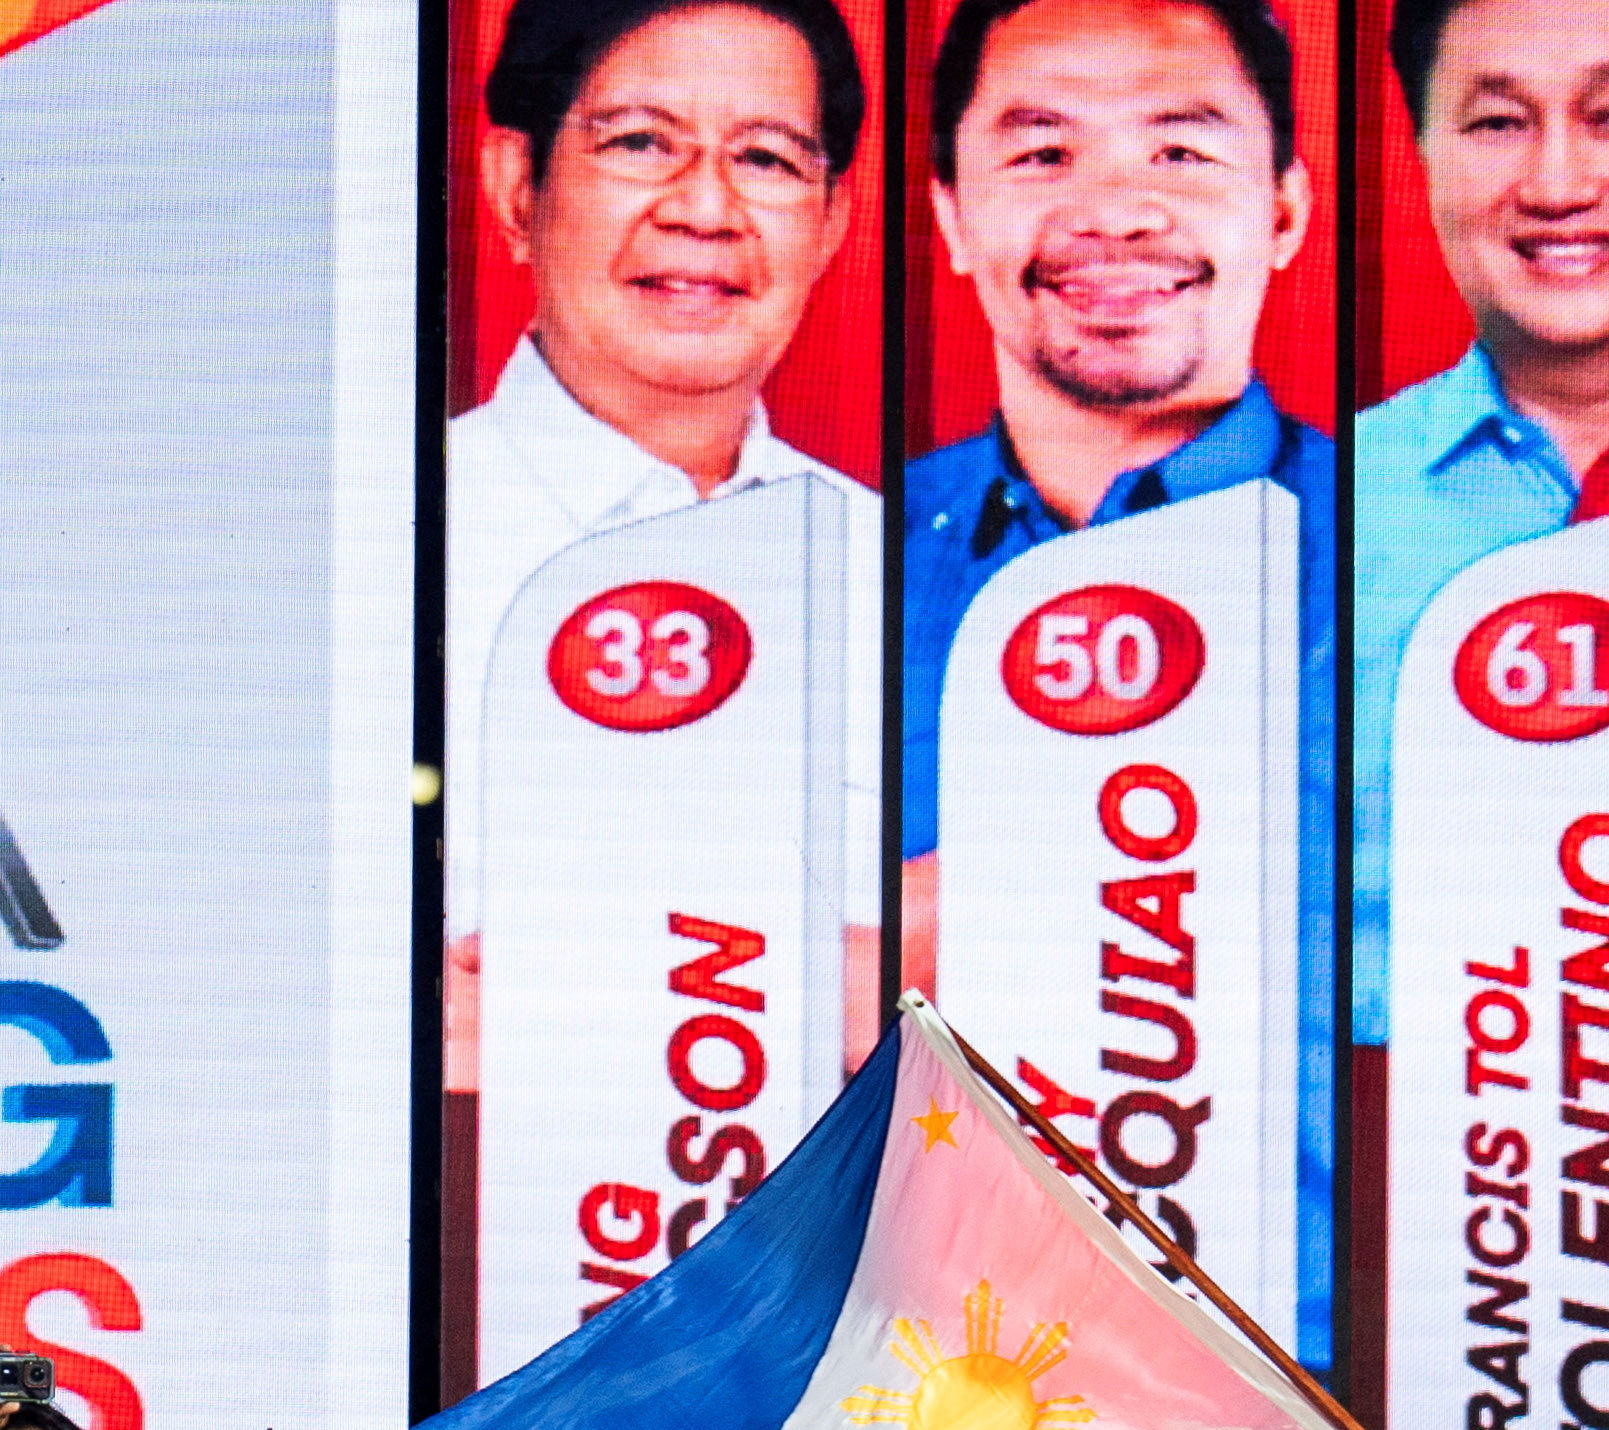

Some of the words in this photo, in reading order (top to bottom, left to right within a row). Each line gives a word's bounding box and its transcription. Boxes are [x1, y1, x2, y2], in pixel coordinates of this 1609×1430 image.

[583, 608, 712, 699] 33
[1032, 613, 1164, 701] 50
[1487, 623, 1609, 709] 61
[1465, 944, 1532, 1095] TOL
